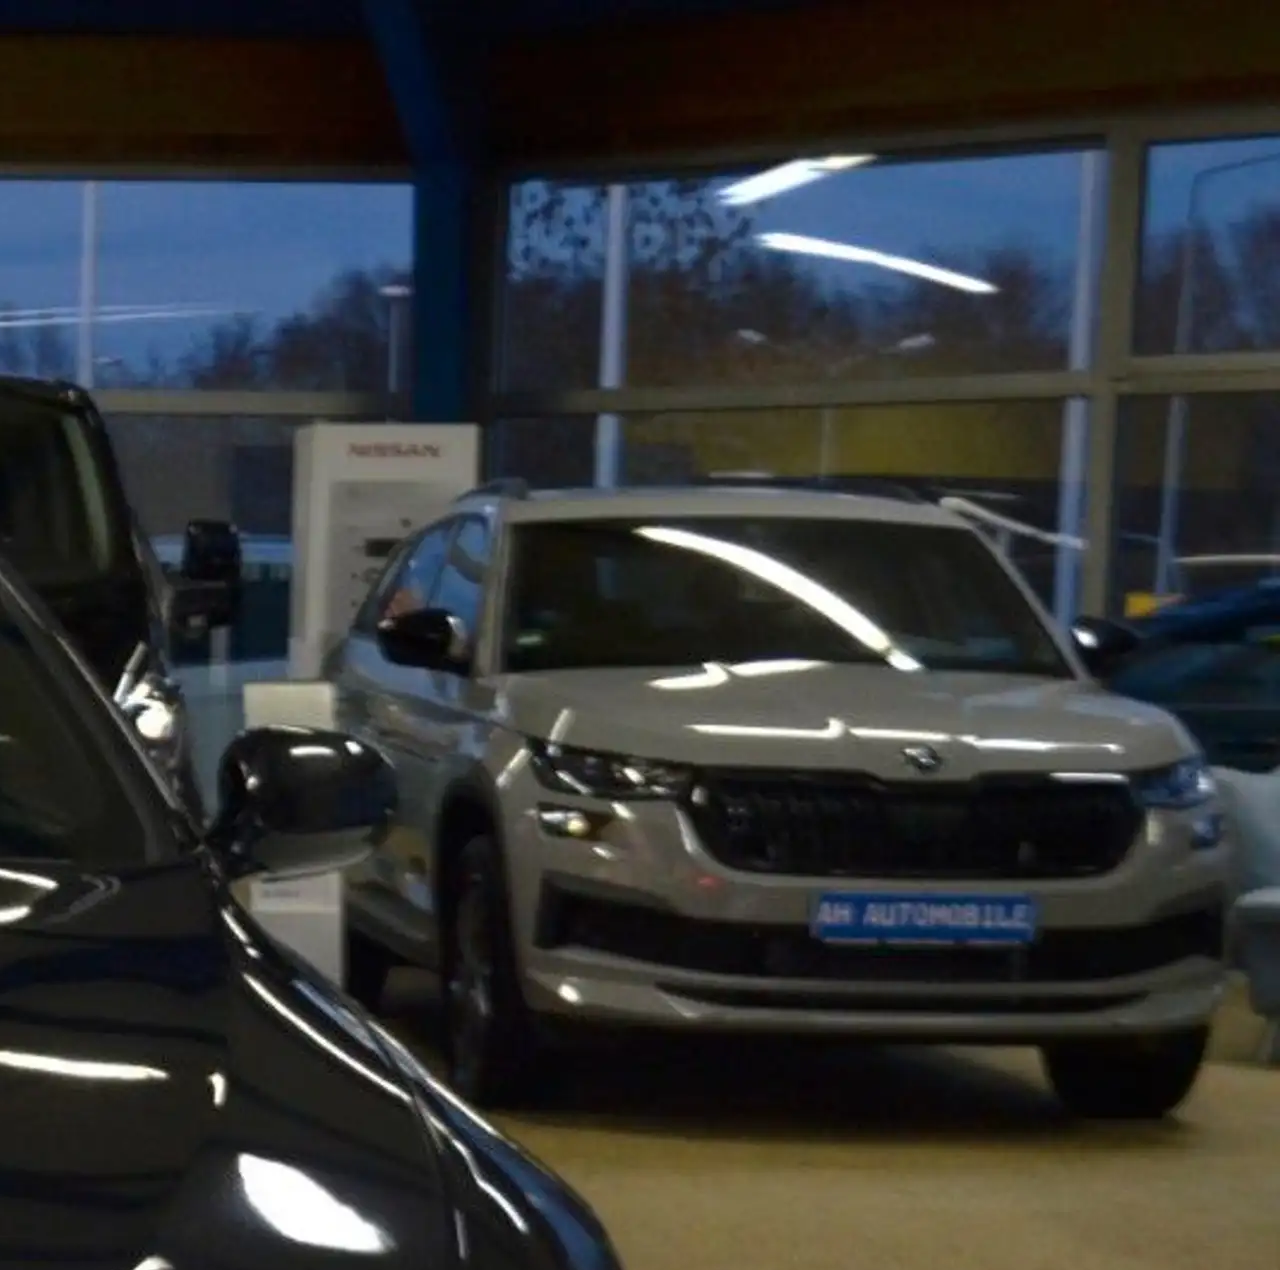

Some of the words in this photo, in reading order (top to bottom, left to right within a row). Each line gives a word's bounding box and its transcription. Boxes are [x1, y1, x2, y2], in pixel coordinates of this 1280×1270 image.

[347, 442, 441, 458] NISSAN
[817, 902, 854, 924] AH
[863, 902, 1033, 929] AUTOMOBILE
